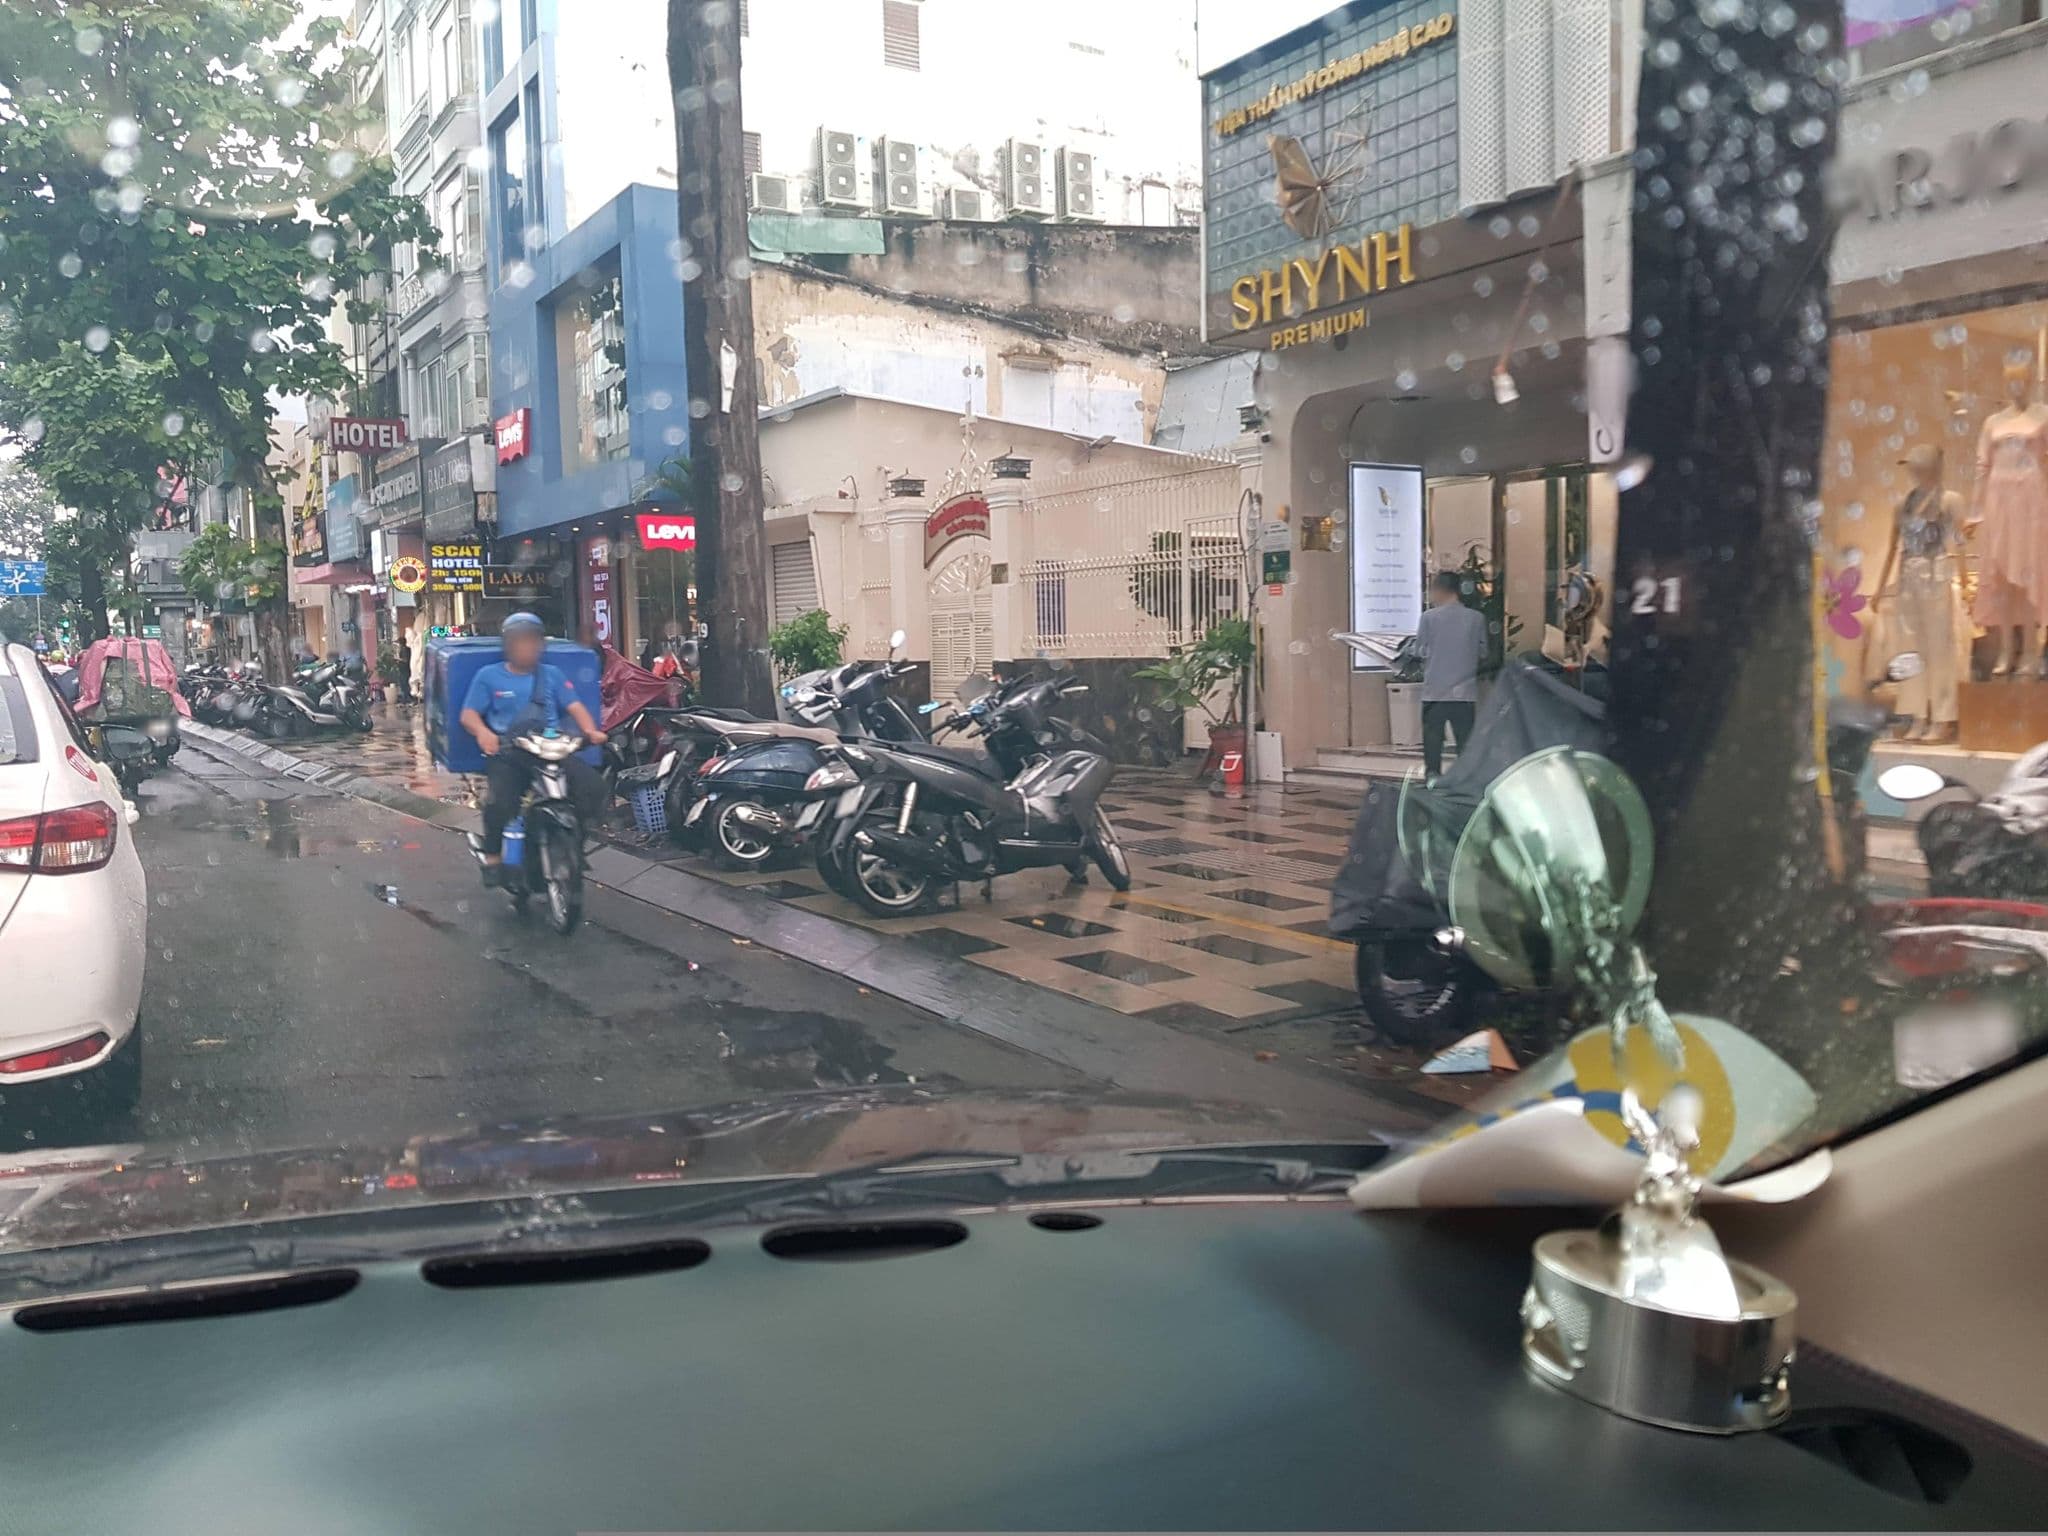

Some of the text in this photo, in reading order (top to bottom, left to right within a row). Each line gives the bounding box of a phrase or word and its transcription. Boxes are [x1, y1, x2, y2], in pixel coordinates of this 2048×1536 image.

[1410, 12, 1453, 48] CAO
[1231, 223, 1415, 331] SHYNH
[1271, 307, 1366, 351] PREMIUM
[333, 422, 404, 449] HOTEL
[431, 545, 482, 557] SCAT
[431, 558, 482, 568] HOTEL
[1631, 575, 1681, 614] 21
